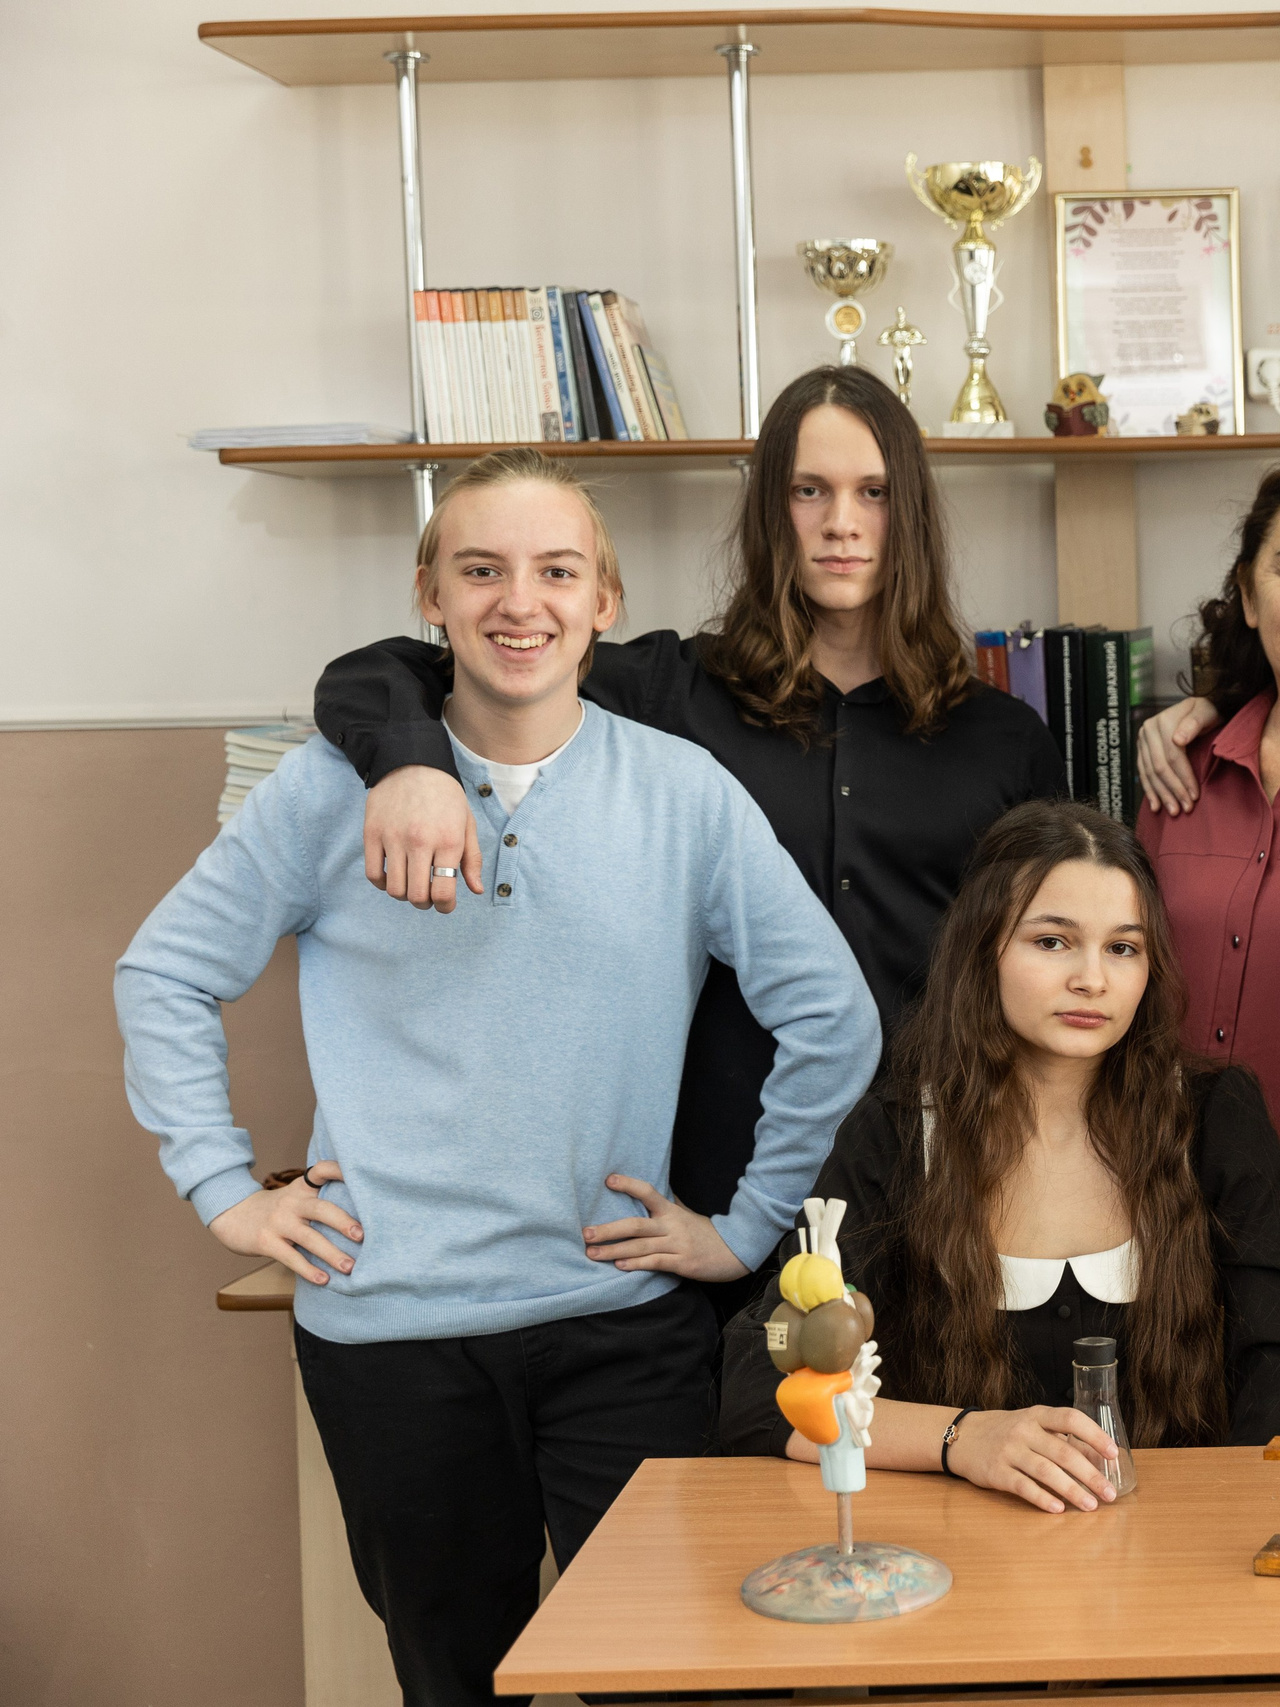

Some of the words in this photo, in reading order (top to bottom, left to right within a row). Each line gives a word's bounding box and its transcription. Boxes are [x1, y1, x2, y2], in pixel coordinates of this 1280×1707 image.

[1103, 641, 1118, 707] ВЫРАЖЕНИЙ
[1107, 708, 1119, 717] И
[1107, 719, 1120, 747] СЛОВ
[1096, 718, 1108, 764] СЛОВАРЬ
[1096, 766, 1111, 817] ОВЕЙШИЙ
